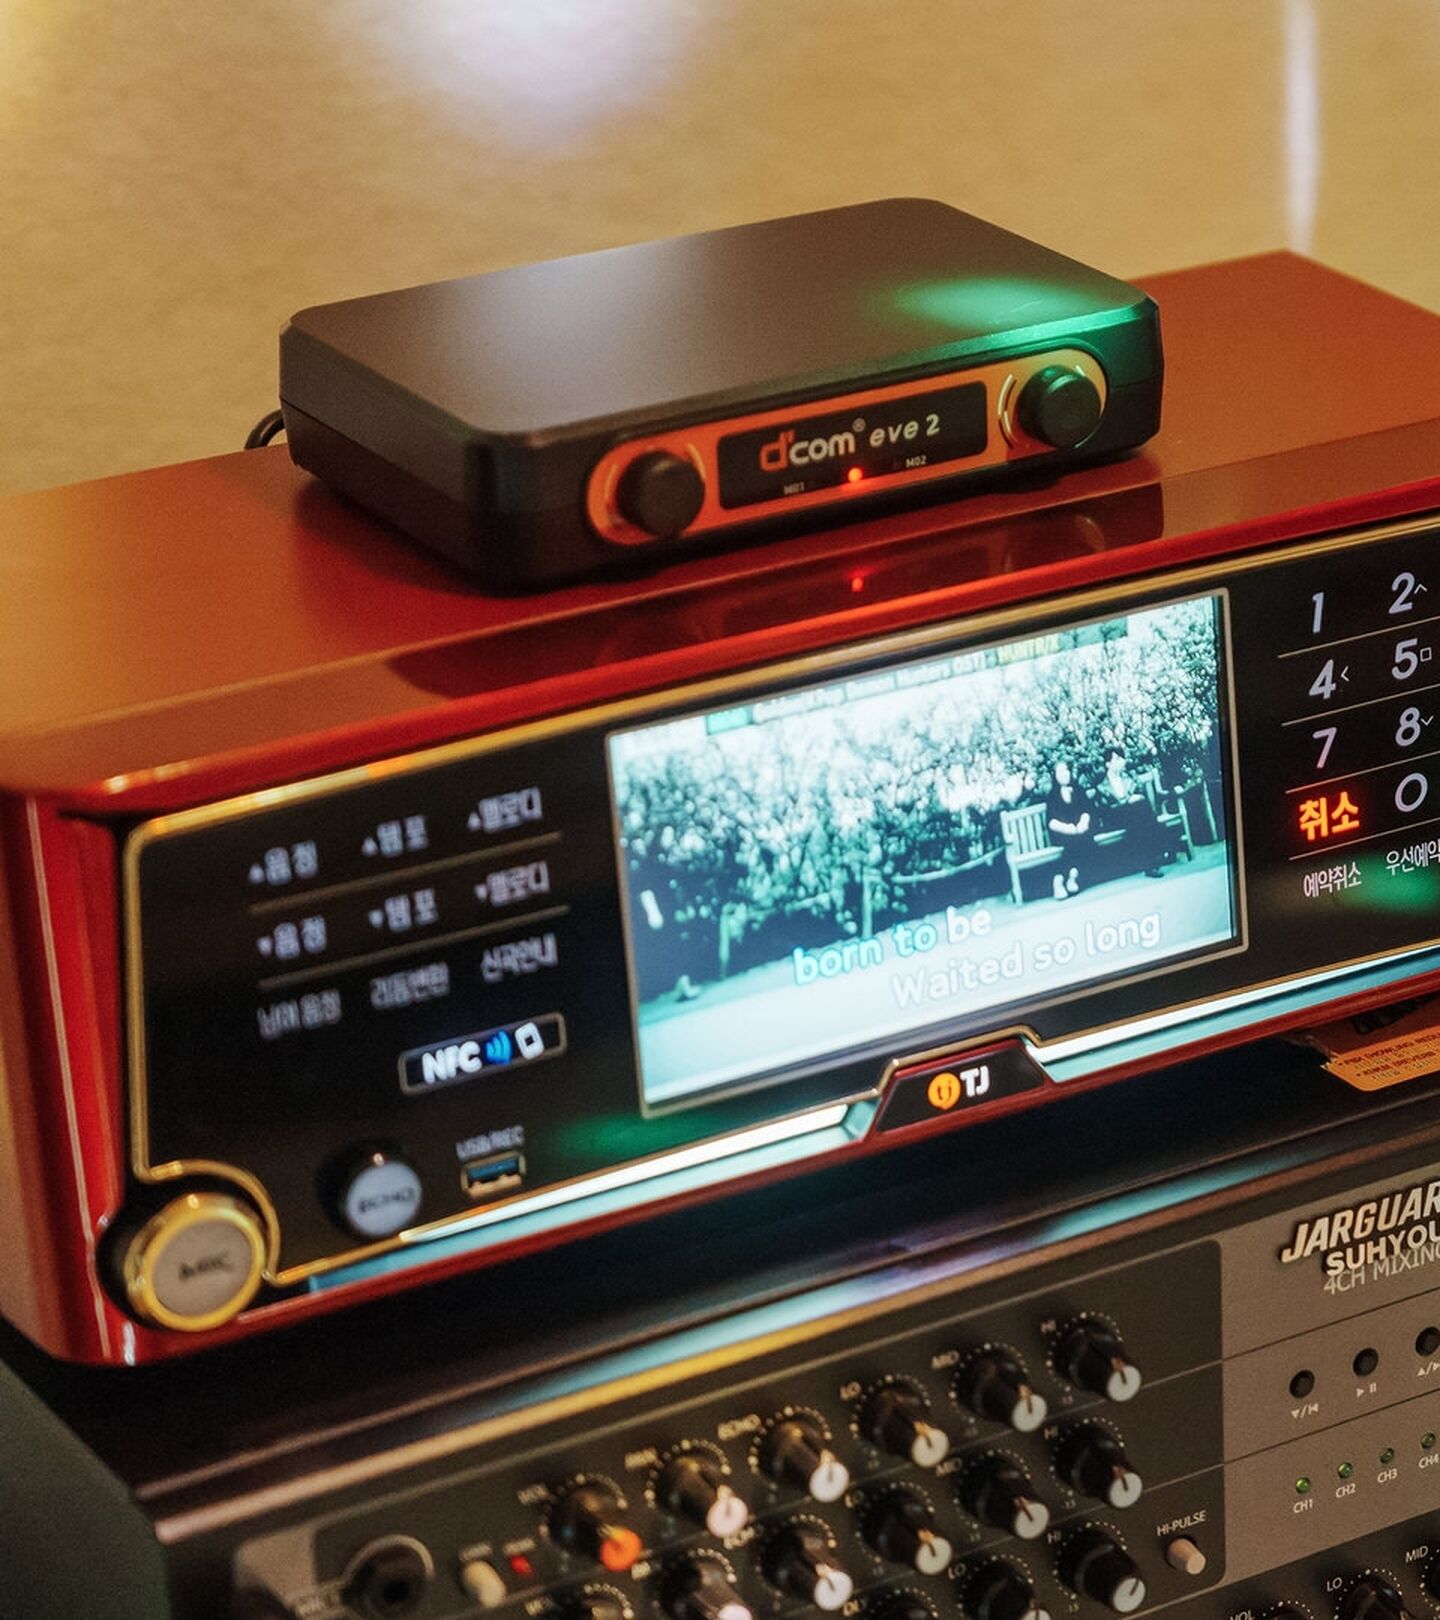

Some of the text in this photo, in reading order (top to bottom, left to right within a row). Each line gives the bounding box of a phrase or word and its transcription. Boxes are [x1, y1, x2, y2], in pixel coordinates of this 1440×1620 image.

[869, 420, 919, 447] eve
[926, 413, 940, 436] 2
[1312, 592, 1324, 633] 1
[1389, 573, 1415, 614] 2
[1309, 660, 1336, 699] 4
[1392, 639, 1419, 679] 5
[1312, 727, 1337, 769] 7
[1395, 707, 1420, 747] 8
[1394, 772, 1428, 812] 0
[1299, 791, 1360, 841] 취소
[1303, 862, 1362, 898] 예약취소
[793, 904, 992, 986] born to be
[893, 911, 1162, 1008] Waited so long
[421, 1041, 482, 1085] NFC
[960, 1065, 990, 1098] TJ
[1324, 1268, 1365, 1295] 4CH
[1377, 1468, 1398, 1483] CH3
[1419, 1453, 1439, 1469] CH4
[1293, 1499, 1314, 1513] CH1
[1335, 1483, 1357, 1498] CH2
[1156, 1510, 1208, 1538] HI-PULSE
[1405, 1546, 1428, 1563] MID
[1326, 1577, 1343, 1593] LO
